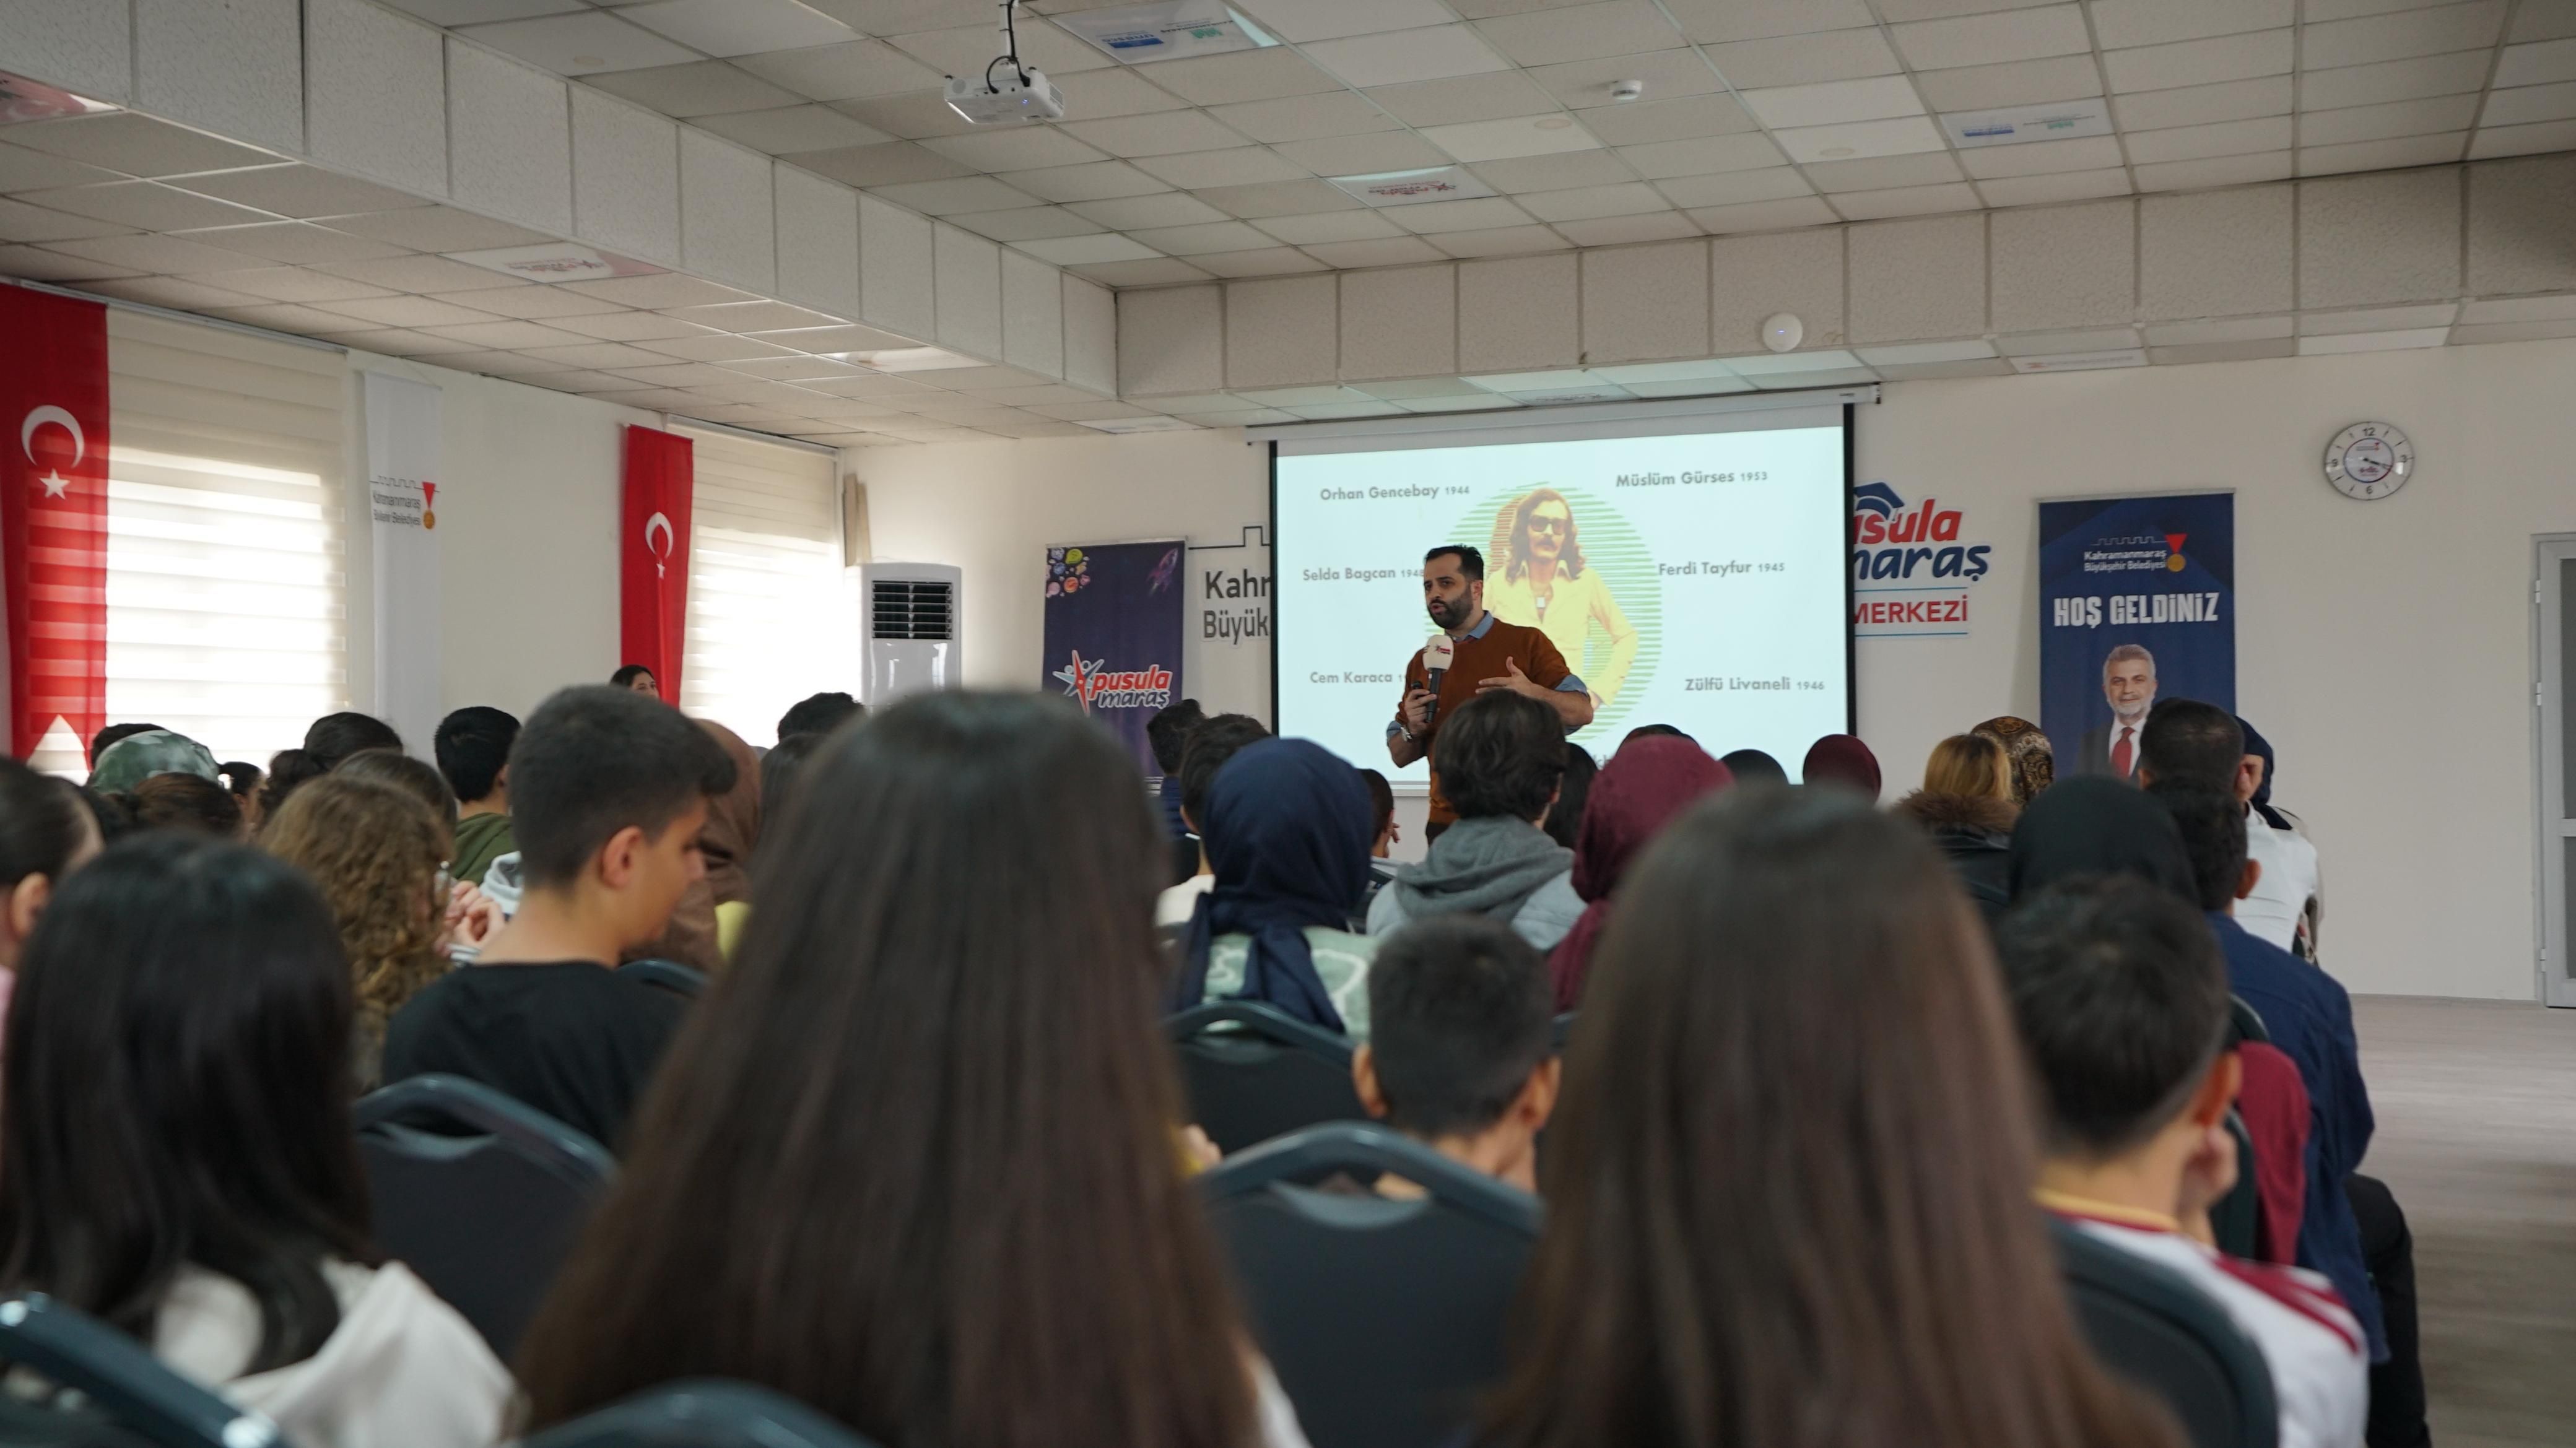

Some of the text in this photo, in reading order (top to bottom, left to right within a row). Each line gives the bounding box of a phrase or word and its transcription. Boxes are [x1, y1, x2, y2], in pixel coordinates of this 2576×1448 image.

[2362, 427, 2375, 436] 12
[2400, 454, 2408, 463] 3
[1616, 471, 1768, 487] Müslüm Gürses 1953
[1320, 483, 1469, 500] Orhan Gencebay 1944
[2366, 485, 2373, 494] 6
[1303, 567, 1339, 581] Selda
[1345, 567, 1396, 582] Bagcan
[1659, 560, 1785, 578] Ferdi Tayfur 1945
[2054, 596, 2102, 629] HOŞ
[1204, 607, 1268, 644] Büyük
[1090, 665, 1171, 699] pusula
[1310, 672, 1339, 683] Cem
[1344, 672, 1393, 683] Karaca
[1685, 676, 1824, 691] Zülfü Livaneli 1946
[1100, 691, 1169, 709] maraş
